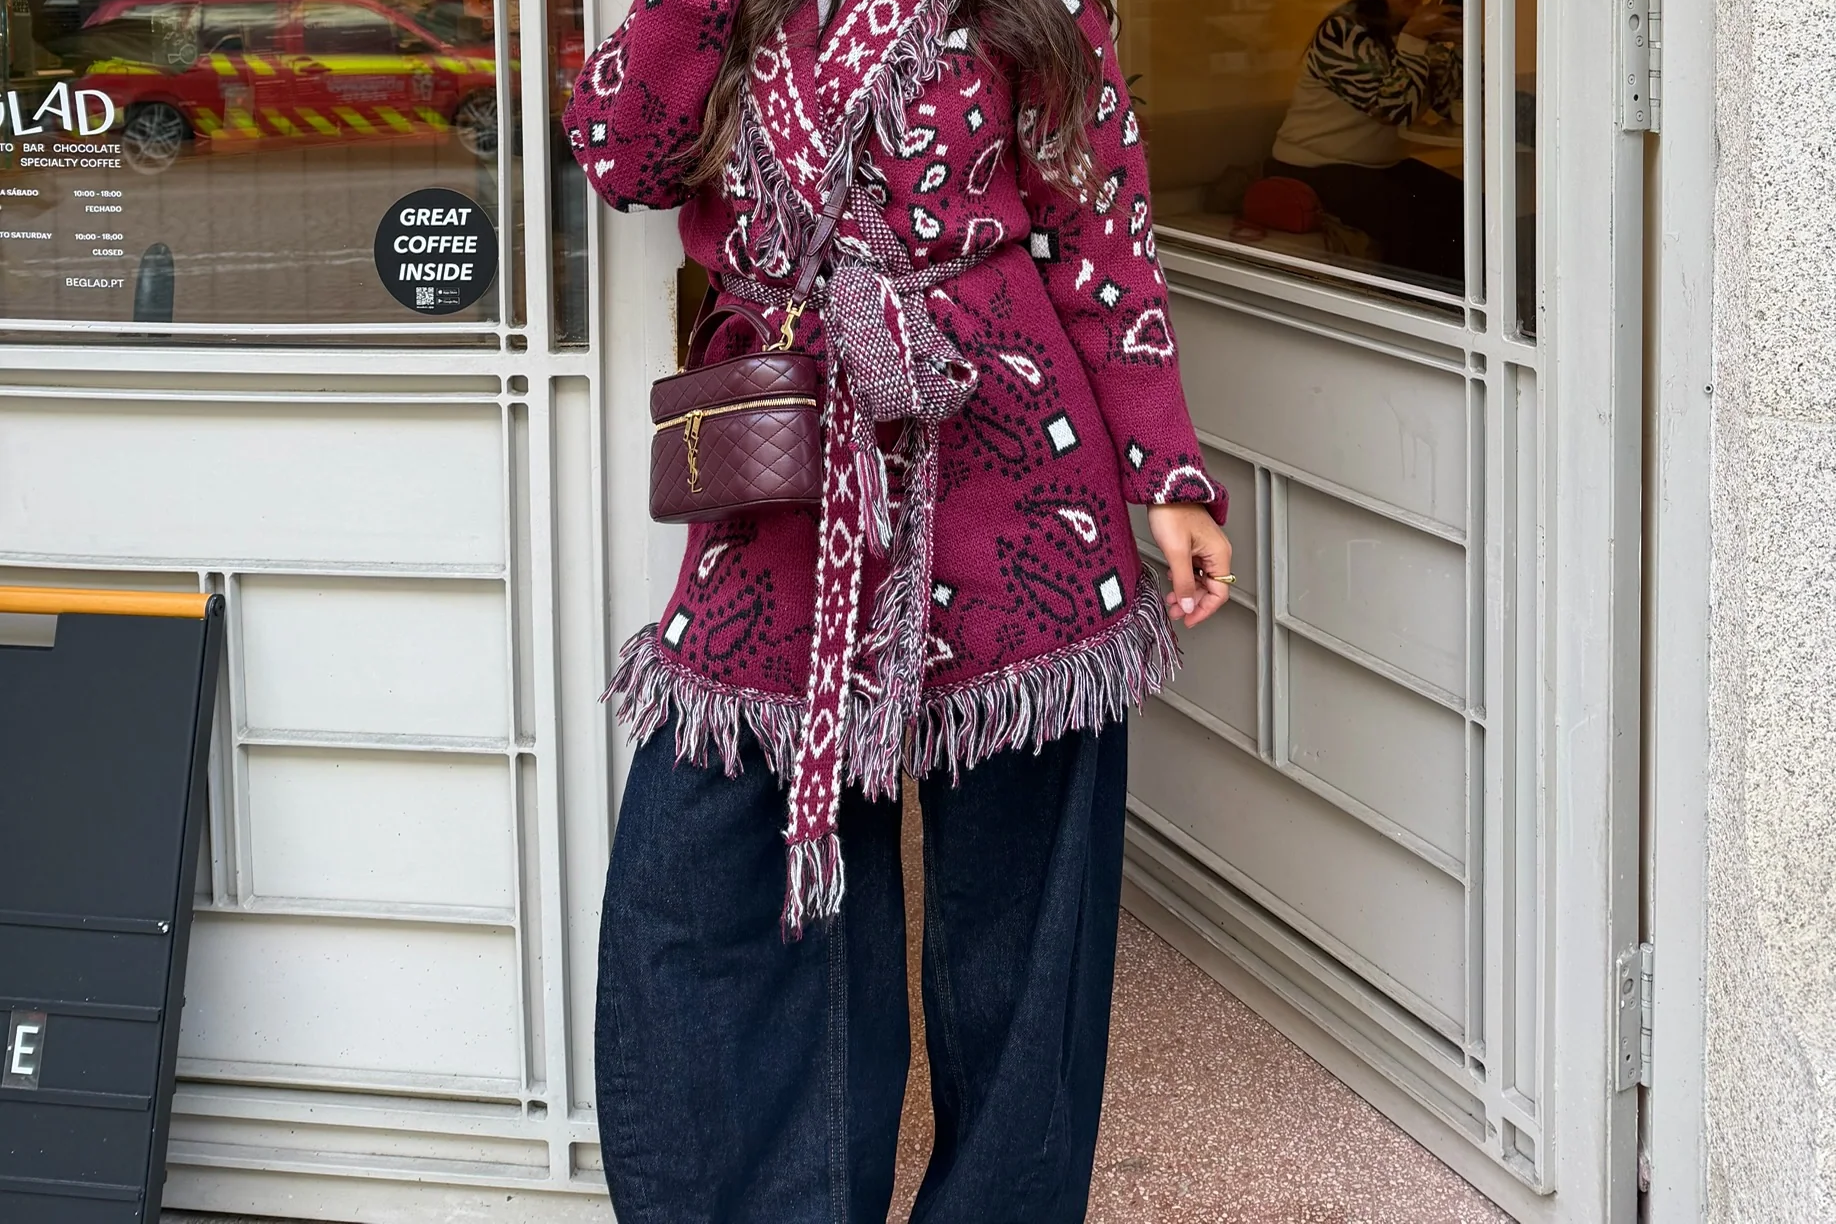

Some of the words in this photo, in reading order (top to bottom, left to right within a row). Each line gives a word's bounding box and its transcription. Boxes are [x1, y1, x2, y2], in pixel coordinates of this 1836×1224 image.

[0, 81, 115, 136] LAD
[23, 143, 45, 152] BAR
[53, 143, 121, 154] CHOCOLATE
[20, 157, 78, 167] SPECIALTY
[80, 158, 122, 168] COFFEE
[7, 188, 38, 196] SÁBADO
[400, 208, 472, 226] GREAT
[393, 235, 478, 254] COFFEE
[398, 263, 474, 281] INSIDE
[66, 278, 124, 288] BEGLAD.PT
[10, 1025, 39, 1075] E
